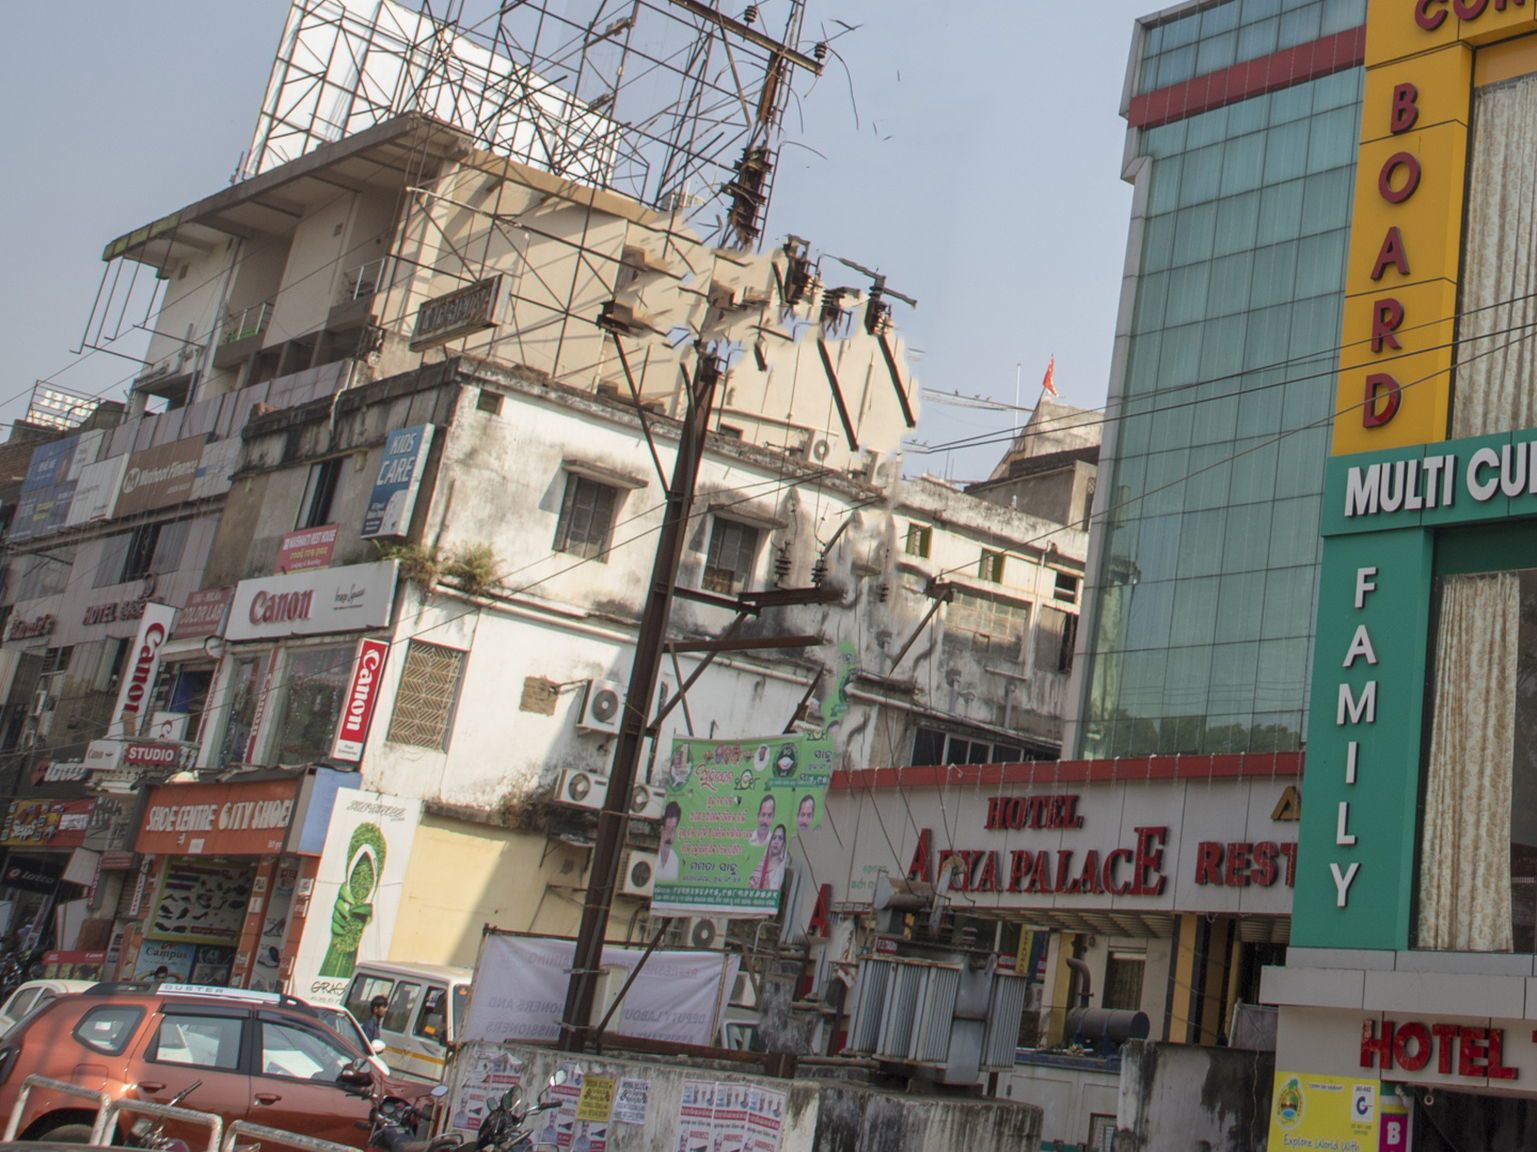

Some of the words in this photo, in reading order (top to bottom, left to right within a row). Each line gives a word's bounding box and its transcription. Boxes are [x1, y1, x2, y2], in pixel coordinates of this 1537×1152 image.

[1361, 81, 1422, 430] BOARD
[389, 432, 417, 456] KIDS
[376, 456, 415, 486] CARE
[1343, 452, 1455, 519] MULTI
[249, 588, 316, 626] Canon
[345, 649, 381, 732] Canon
[128, 746, 174, 762] STUDIO
[1330, 565, 1379, 909] FAMILY
[984, 793, 1084, 831] HOTEL
[1006, 825, 1169, 897] PALACE
[146, 946, 188, 961] Campus
[163, 984, 224, 994] DUSTER
[1358, 1018, 1521, 1083] HOTEL
